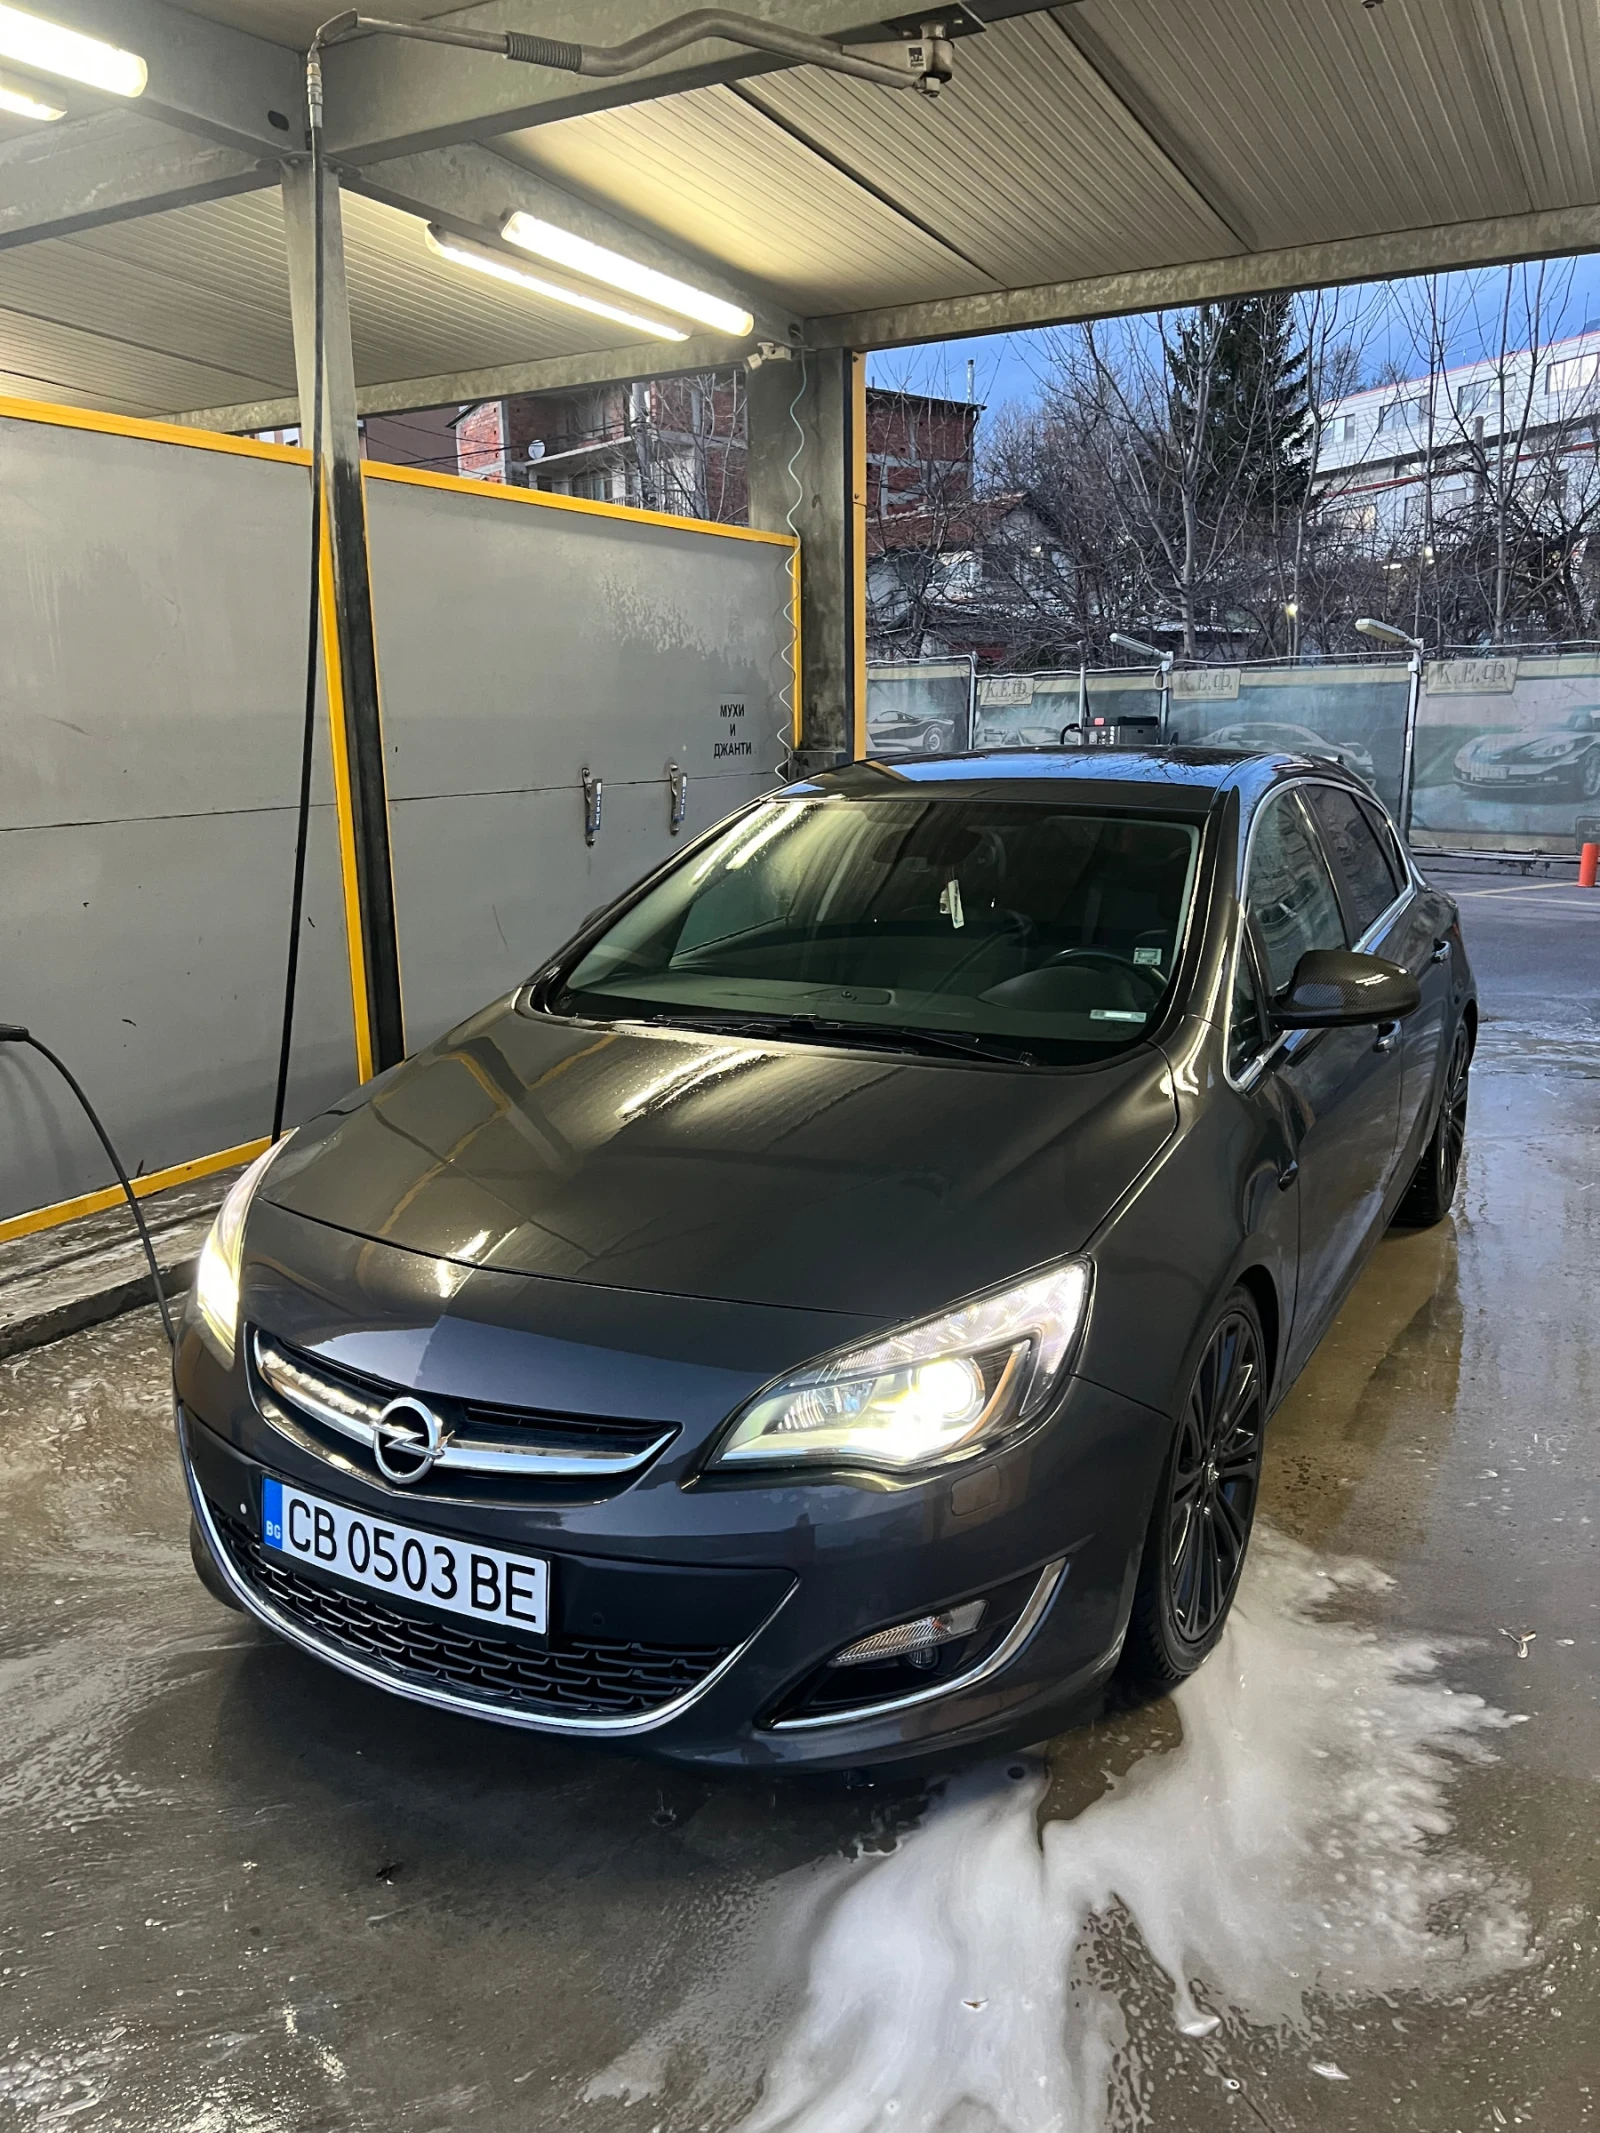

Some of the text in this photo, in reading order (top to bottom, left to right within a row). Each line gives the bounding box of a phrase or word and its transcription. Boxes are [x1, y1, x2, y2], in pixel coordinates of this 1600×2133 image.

[720, 704, 745, 717] МУХИ
[729, 723, 736, 737] И
[713, 742, 752, 759] ДЖАНТИ
[266, 1520, 281, 1540] BG
[347, 1520, 458, 1600] 0503
